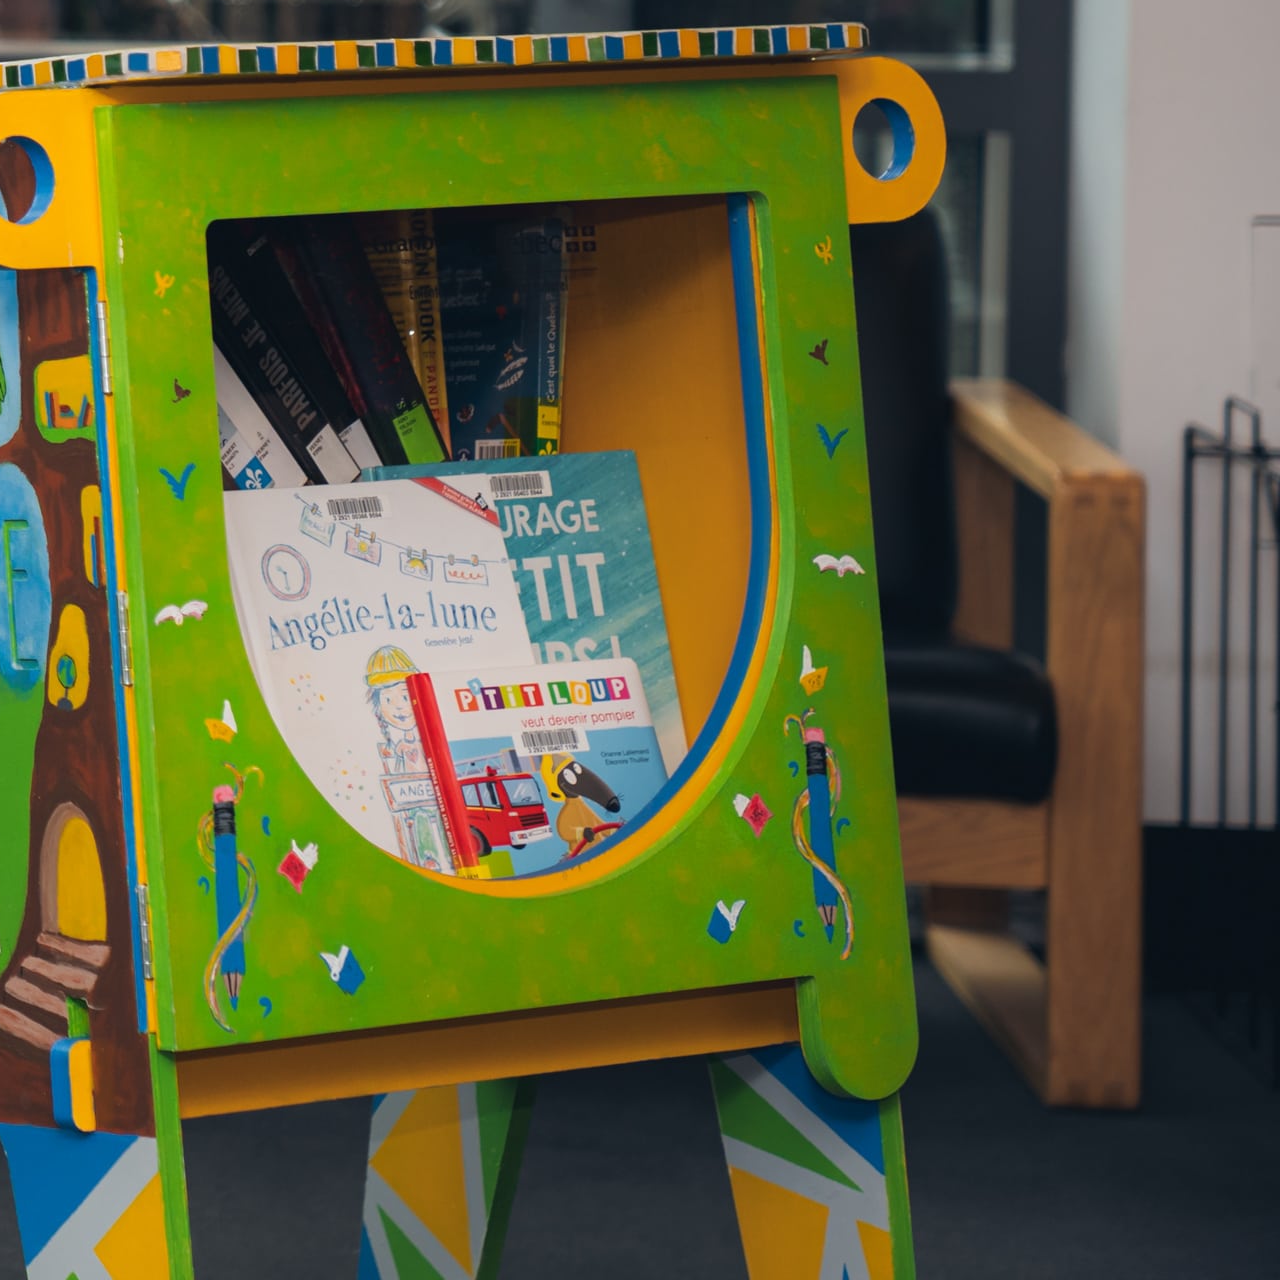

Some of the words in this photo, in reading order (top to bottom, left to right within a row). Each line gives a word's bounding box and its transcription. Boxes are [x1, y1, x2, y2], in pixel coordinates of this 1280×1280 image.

[211, 265, 252, 329] MENS
[241, 322, 267, 350] JE
[258, 345, 318, 432] PARFOIS
[269, 590, 498, 652] Angélie-la-lune
[424, 636, 458, 648] Geneviève
[554, 679, 627, 706] LOUP
[521, 717, 545, 728] veut
[548, 714, 588, 726] devenir
[592, 711, 636, 725] pompier
